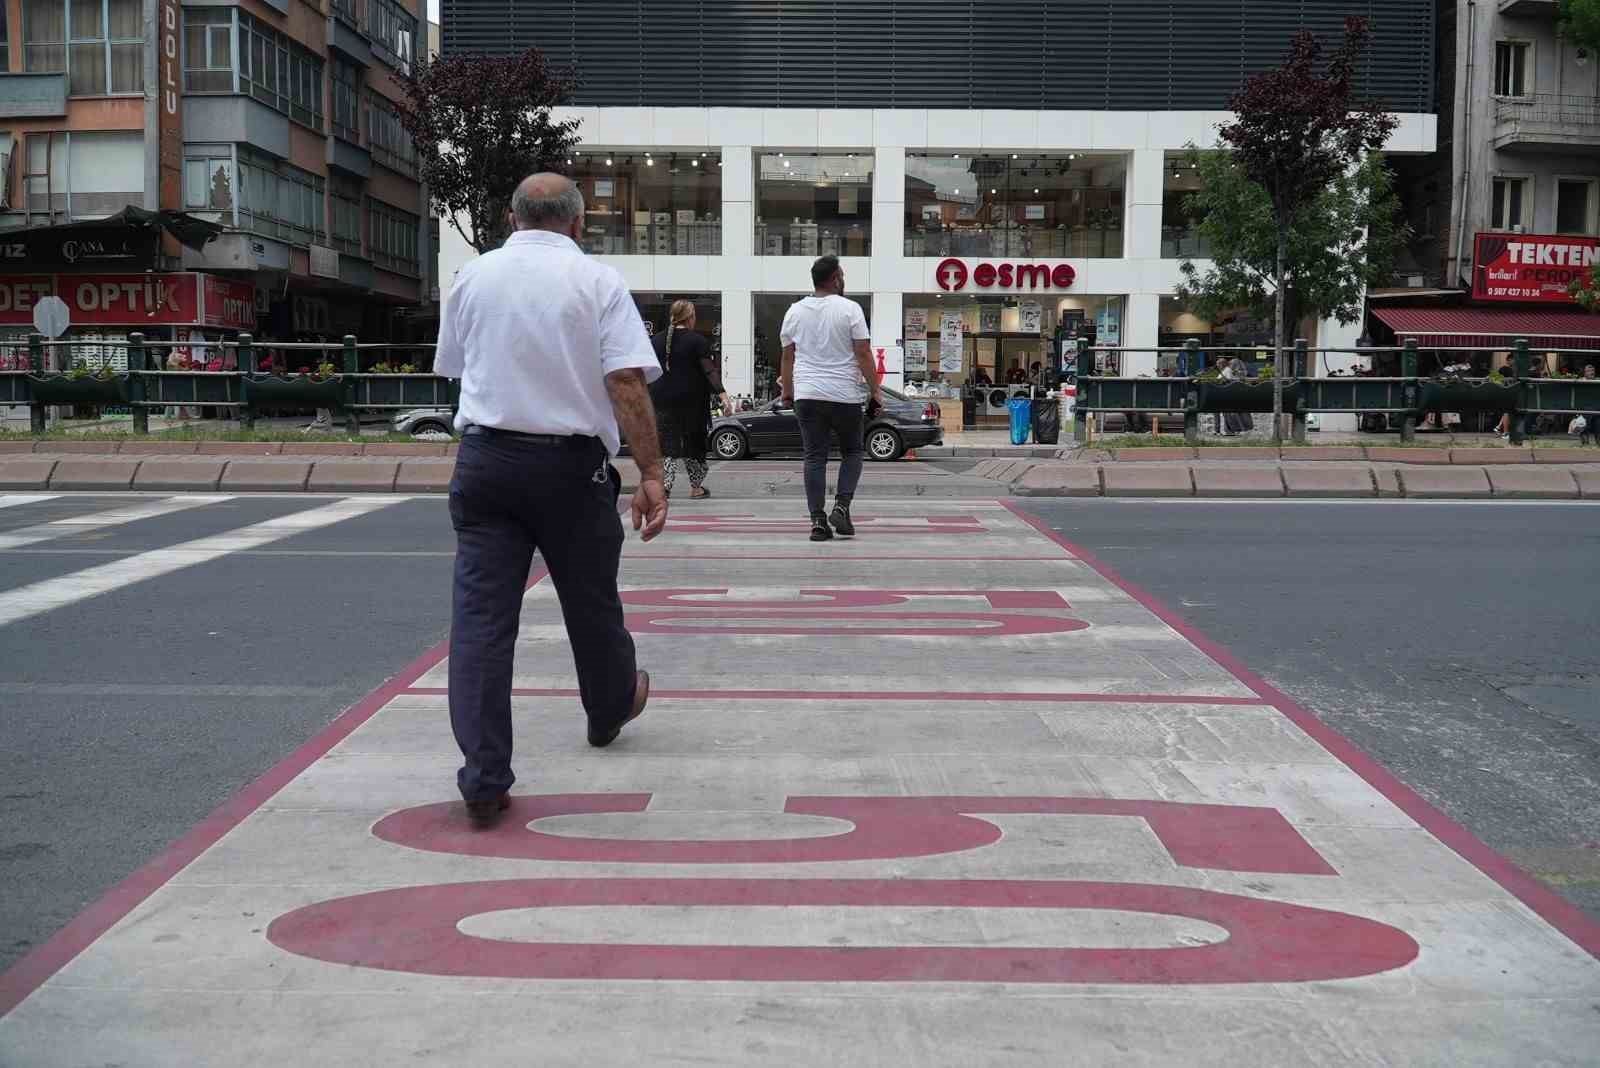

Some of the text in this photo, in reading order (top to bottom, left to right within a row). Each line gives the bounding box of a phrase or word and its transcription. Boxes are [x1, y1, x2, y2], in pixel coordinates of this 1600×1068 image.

[165, 0, 177, 114] DOLU
[1507, 242, 1600, 268] TEKTEN
[974, 263, 1076, 288] esme
